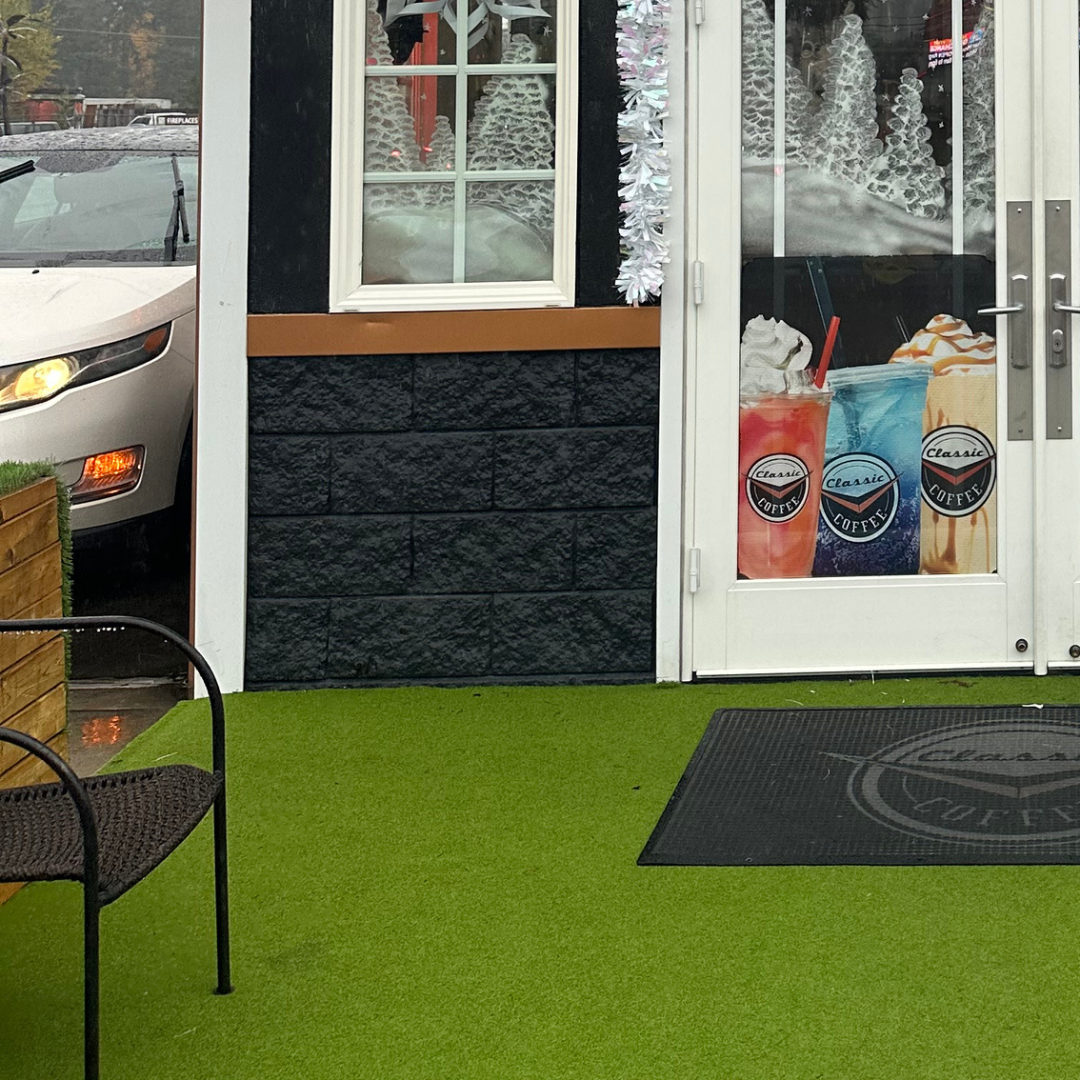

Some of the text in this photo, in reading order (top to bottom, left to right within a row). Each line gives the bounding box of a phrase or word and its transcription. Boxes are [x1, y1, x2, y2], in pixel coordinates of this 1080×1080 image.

[926, 447, 986, 459] Classic
[755, 469, 802, 479] Classic
[826, 473, 886, 489] Classic
[929, 483, 983, 506] COFFEE
[757, 496, 801, 515] COFFEE
[833, 508, 888, 534] COFFEE
